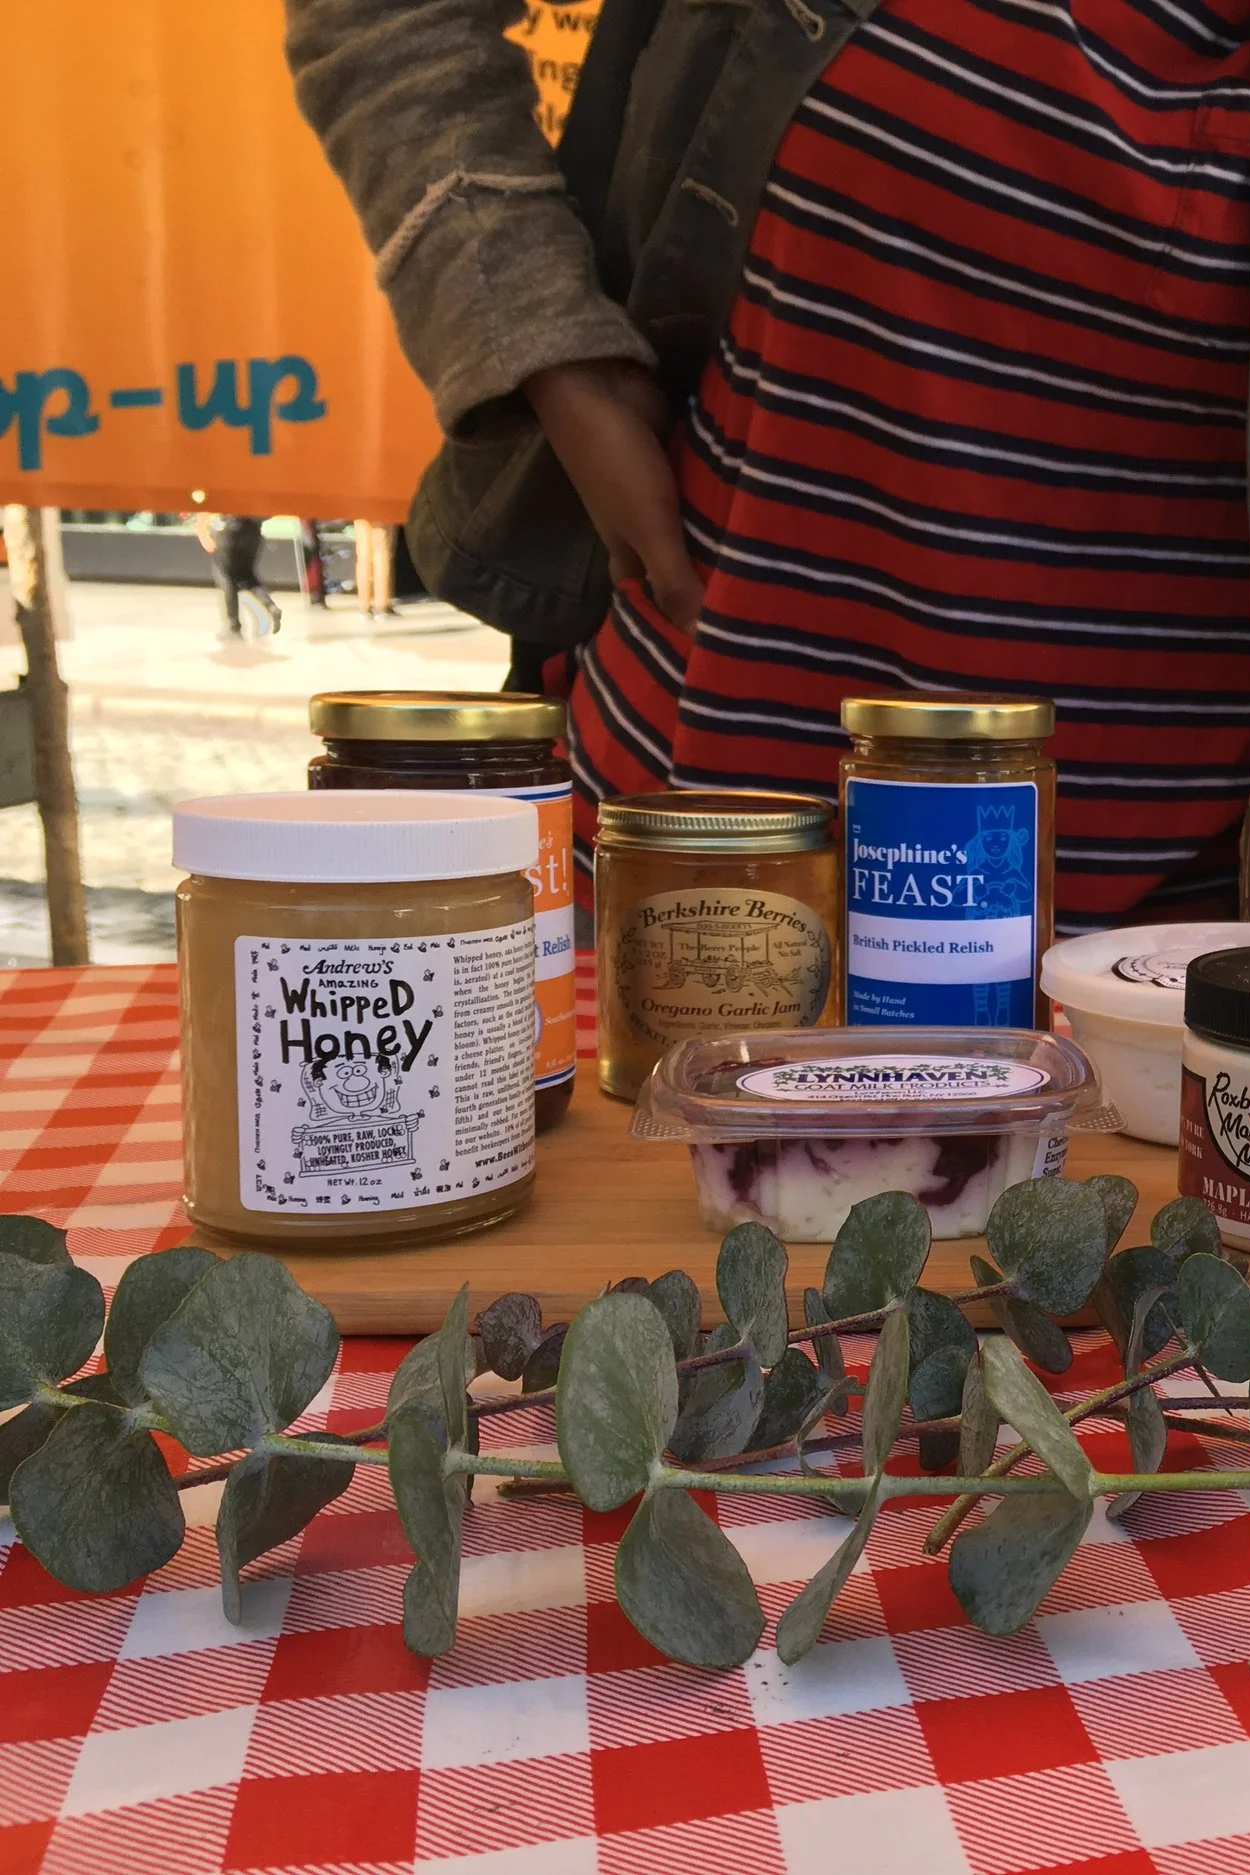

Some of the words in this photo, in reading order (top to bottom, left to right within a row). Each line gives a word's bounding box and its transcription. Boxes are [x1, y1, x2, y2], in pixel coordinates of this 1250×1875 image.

[853, 838, 968, 870] Josephine's
[640, 900, 741, 928] Berkshire
[744, 899, 808, 932] Berries
[853, 934, 889, 951] British
[892, 939, 944, 953] Pickled
[949, 940, 994, 954] Relish
[453, 952, 483, 964] Whipped
[485, 951, 503, 961] honey,
[454, 967, 460, 975] is
[462, 966, 469, 974] in
[471, 964, 483, 973] fact
[464, 973, 491, 985] aerated)
[453, 988, 472, 997] when
[479, 984, 489, 993] the
[882, 995, 906, 1006] Hand
[454, 1010, 471, 1018] from
[472, 1006, 495, 1015] creamy
[641, 998, 713, 1018] Oregano
[718, 1001, 770, 1018] Garlic
[770, 1000, 801, 1017] Jam
[881, 1008, 915, 1019] Batches
[454, 1020, 480, 1029] factors,
[482, 1014, 496, 1024] such
[454, 1031, 475, 1040] honey
[280, 1018, 434, 1072] Honey
[454, 1039, 481, 1050] bloom).
[461, 1049, 484, 1060] cheese
[454, 1060, 480, 1071] friends,
[455, 1072, 475, 1082] under
[479, 1069, 487, 1078] 12
[796, 1070, 989, 1084] LYNNHAVEN
[455, 1083, 478, 1093] cannot
[481, 1078, 494, 1088] read
[794, 1082, 845, 1091] GOAT
[855, 1081, 895, 1090] MILK
[900, 1080, 992, 1089] PRODUCTS
[455, 1095, 470, 1104] This
[473, 1092, 479, 1100] is
[455, 1103, 477, 1115] fourth
[478, 1097, 508, 1111] generation
[455, 1115, 473, 1125] fifth)
[477, 1111, 489, 1120] and
[455, 1121, 488, 1136] minimally
[333, 1131, 354, 1143] PURE,
[356, 1129, 375, 1141] RAW,
[455, 1138, 463, 1146] to
[464, 1136, 477, 1144] our
[317, 1143, 354, 1156] LOVINGLY
[355, 1138, 396, 1151] PRODUCED,
[455, 1144, 479, 1157] benefit
[351, 1151, 380, 1163] KOSHER
[360, 1177, 368, 1186] 12
